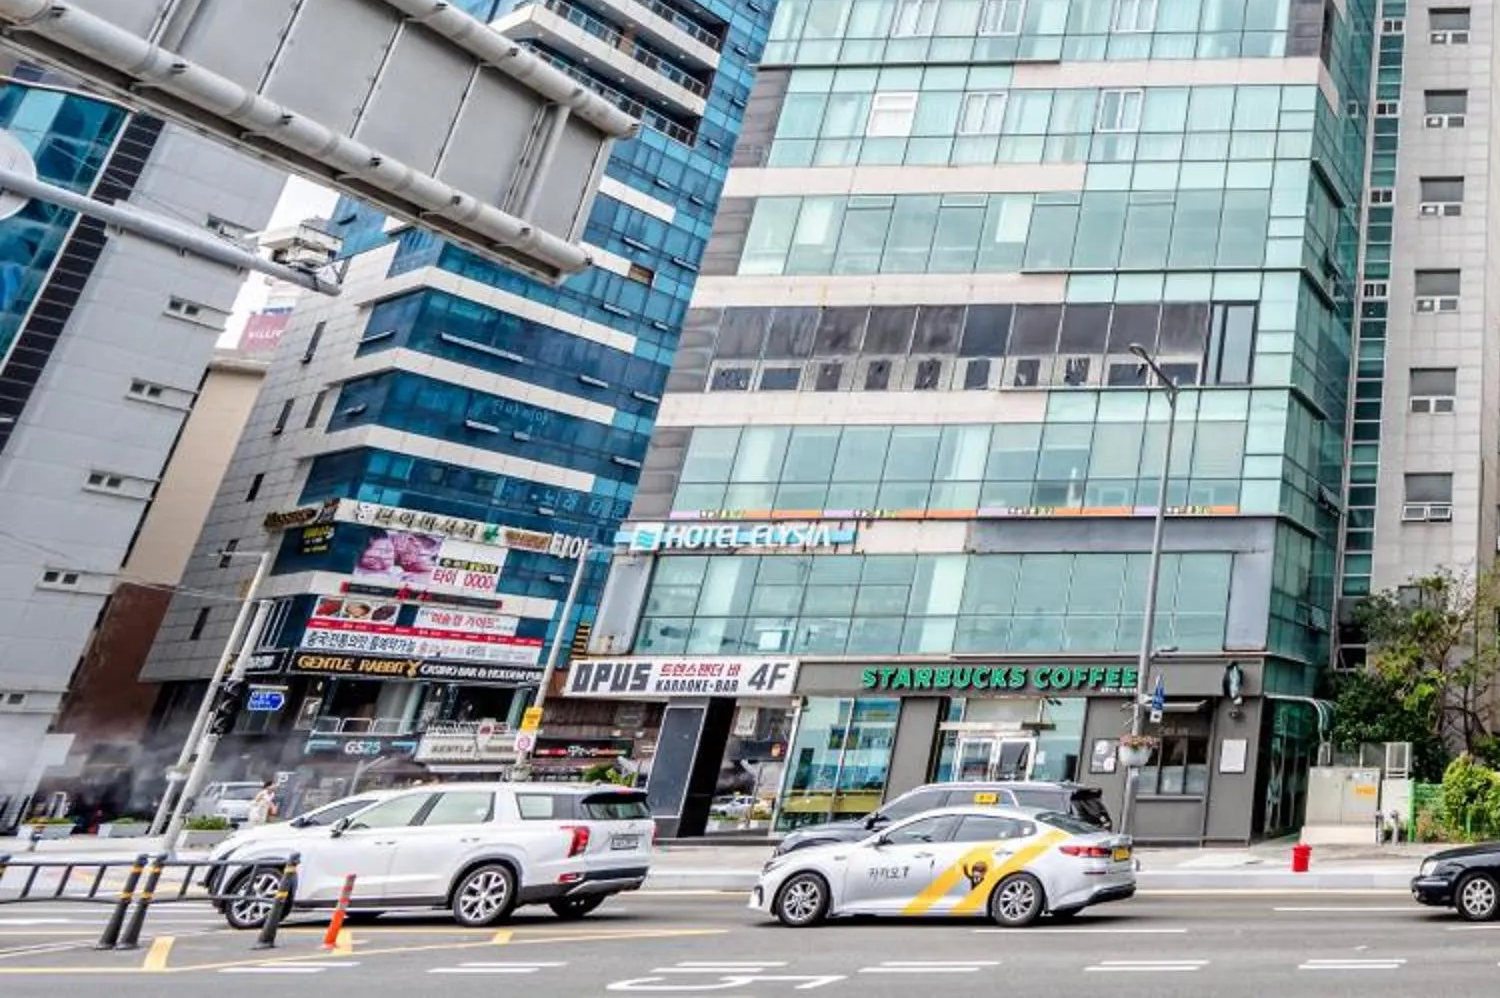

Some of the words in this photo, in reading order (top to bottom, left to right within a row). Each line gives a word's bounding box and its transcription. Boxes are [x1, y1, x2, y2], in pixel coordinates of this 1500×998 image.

[664, 524, 739, 549] HOTEL
[751, 524, 832, 548] ELYSIA
[297, 654, 353, 671] GENTLE
[571, 662, 652, 693] OPUS
[748, 662, 792, 691] 4F
[862, 665, 1027, 691] STARBUCKS
[1031, 665, 1140, 690] COFFEE
[344, 740, 381, 755] GS25
[868, 866, 902, 881] 카카오
